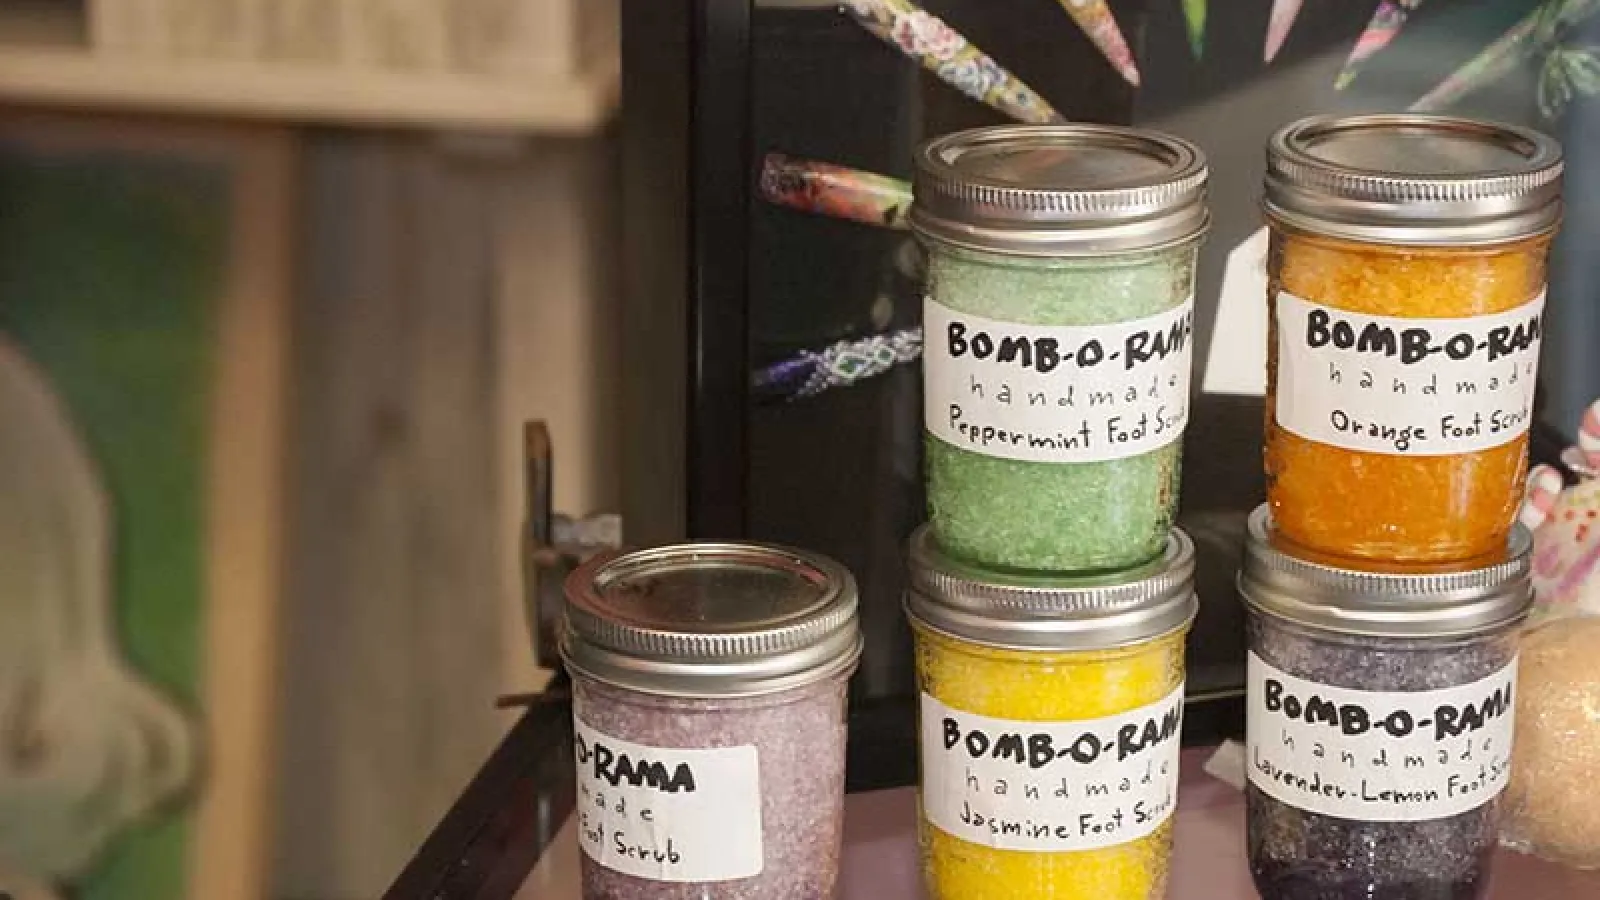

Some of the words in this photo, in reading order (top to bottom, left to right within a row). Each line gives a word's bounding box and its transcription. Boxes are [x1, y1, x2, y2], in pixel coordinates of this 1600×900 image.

[950, 404, 1092, 449] Peppermint
[1108, 412, 1148, 444] Foot
[1331, 410, 1428, 451] Orange
[1441, 412, 1483, 440] Foot
[1447, 763, 1487, 799] Foot
[960, 801, 1070, 839] Jasmine
[1079, 807, 1123, 836] Foot
[614, 830, 680, 864] Scrub
